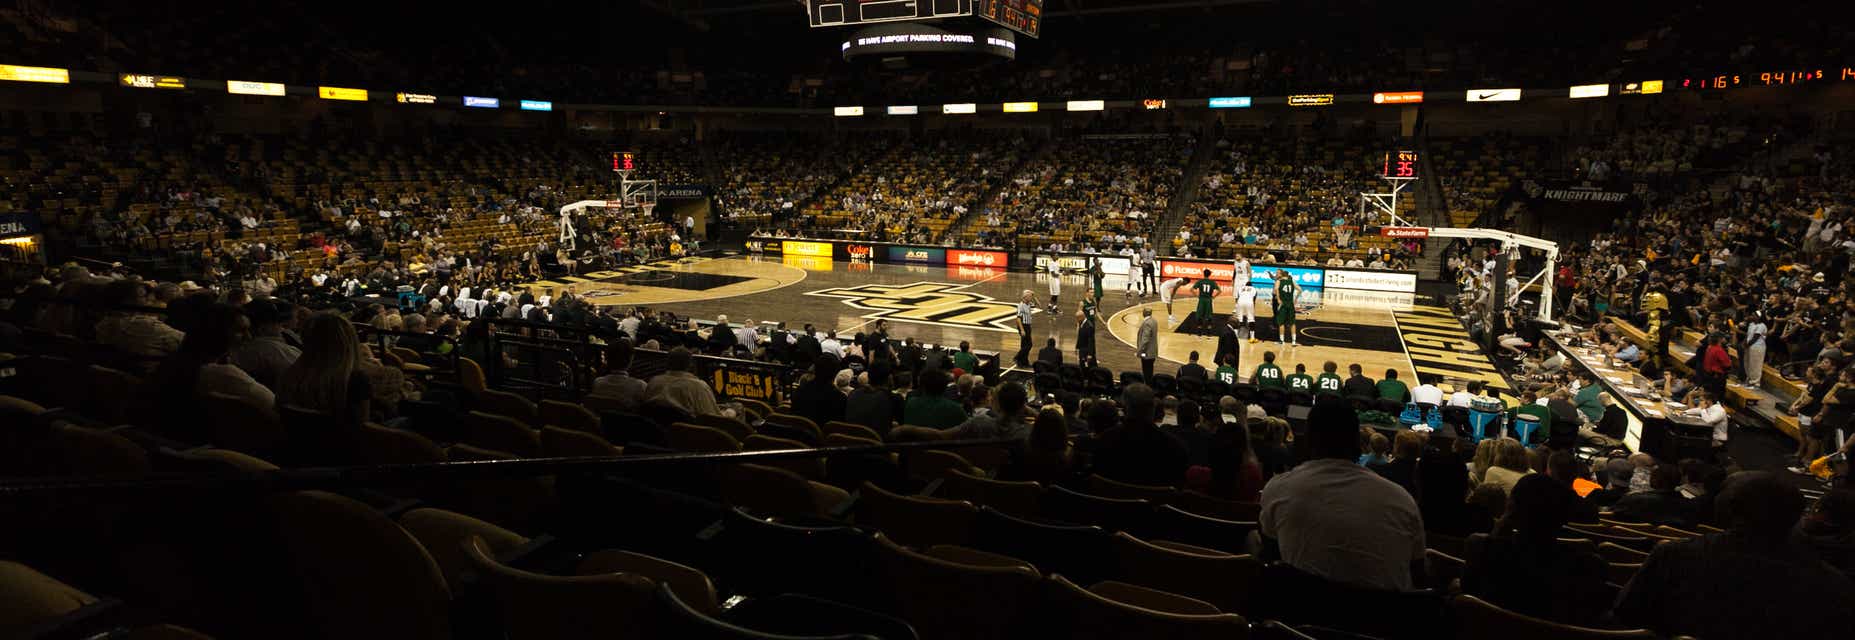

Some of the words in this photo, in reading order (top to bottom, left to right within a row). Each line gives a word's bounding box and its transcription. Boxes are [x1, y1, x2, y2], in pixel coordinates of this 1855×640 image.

[881, 35, 909, 43] AIRPORT
[909, 34, 941, 42] PARKING
[1713, 75, 1727, 88] 16
[1396, 161, 1413, 176] 35
[847, 244, 869, 255] Coke
[1175, 265, 1201, 275] FLORIDA
[1202, 283, 1211, 293] 11
[1282, 284, 1292, 293] 41
[1220, 372, 1233, 385] 15
[1261, 368, 1278, 379] 40
[1292, 378, 1308, 389] 24
[1321, 378, 1338, 390] 20
[726, 384, 744, 396] Gold
[745, 384, 765, 398] Club
